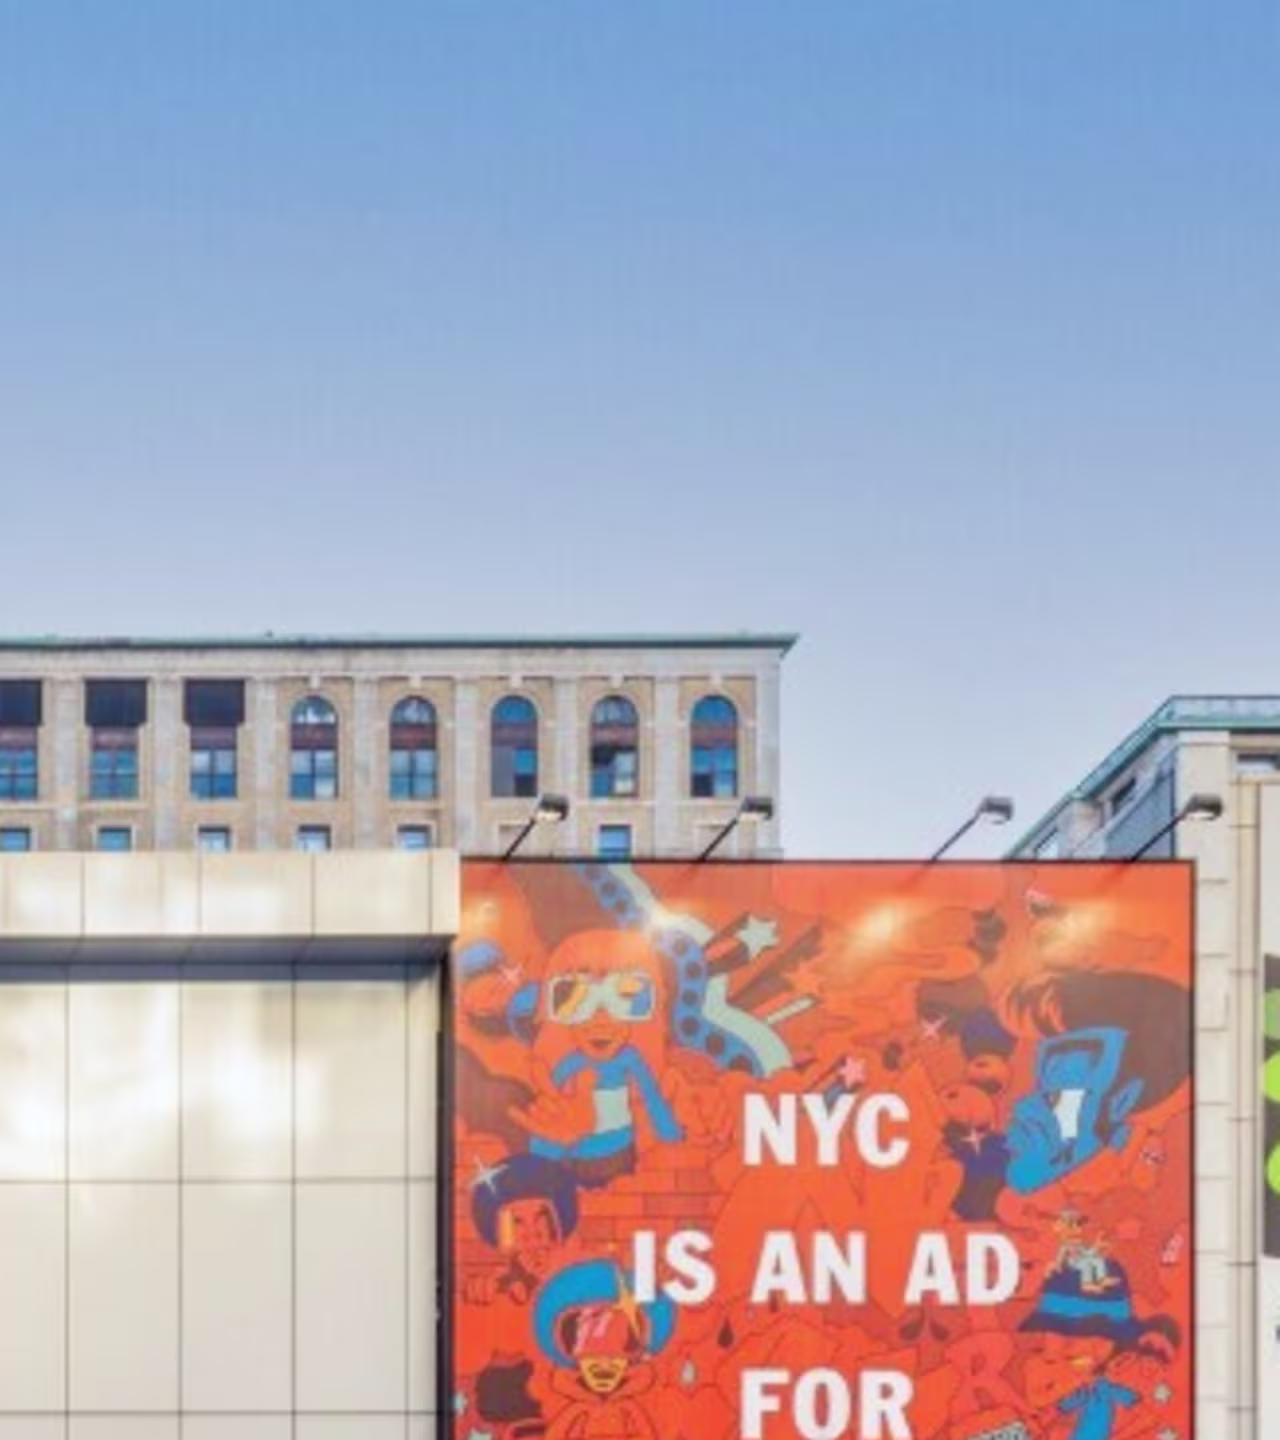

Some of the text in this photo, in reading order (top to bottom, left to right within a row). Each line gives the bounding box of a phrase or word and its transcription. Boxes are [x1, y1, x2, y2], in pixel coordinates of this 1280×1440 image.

[741, 1092, 911, 1167] NYC
[633, 1230, 1022, 1305] IS AN AD
